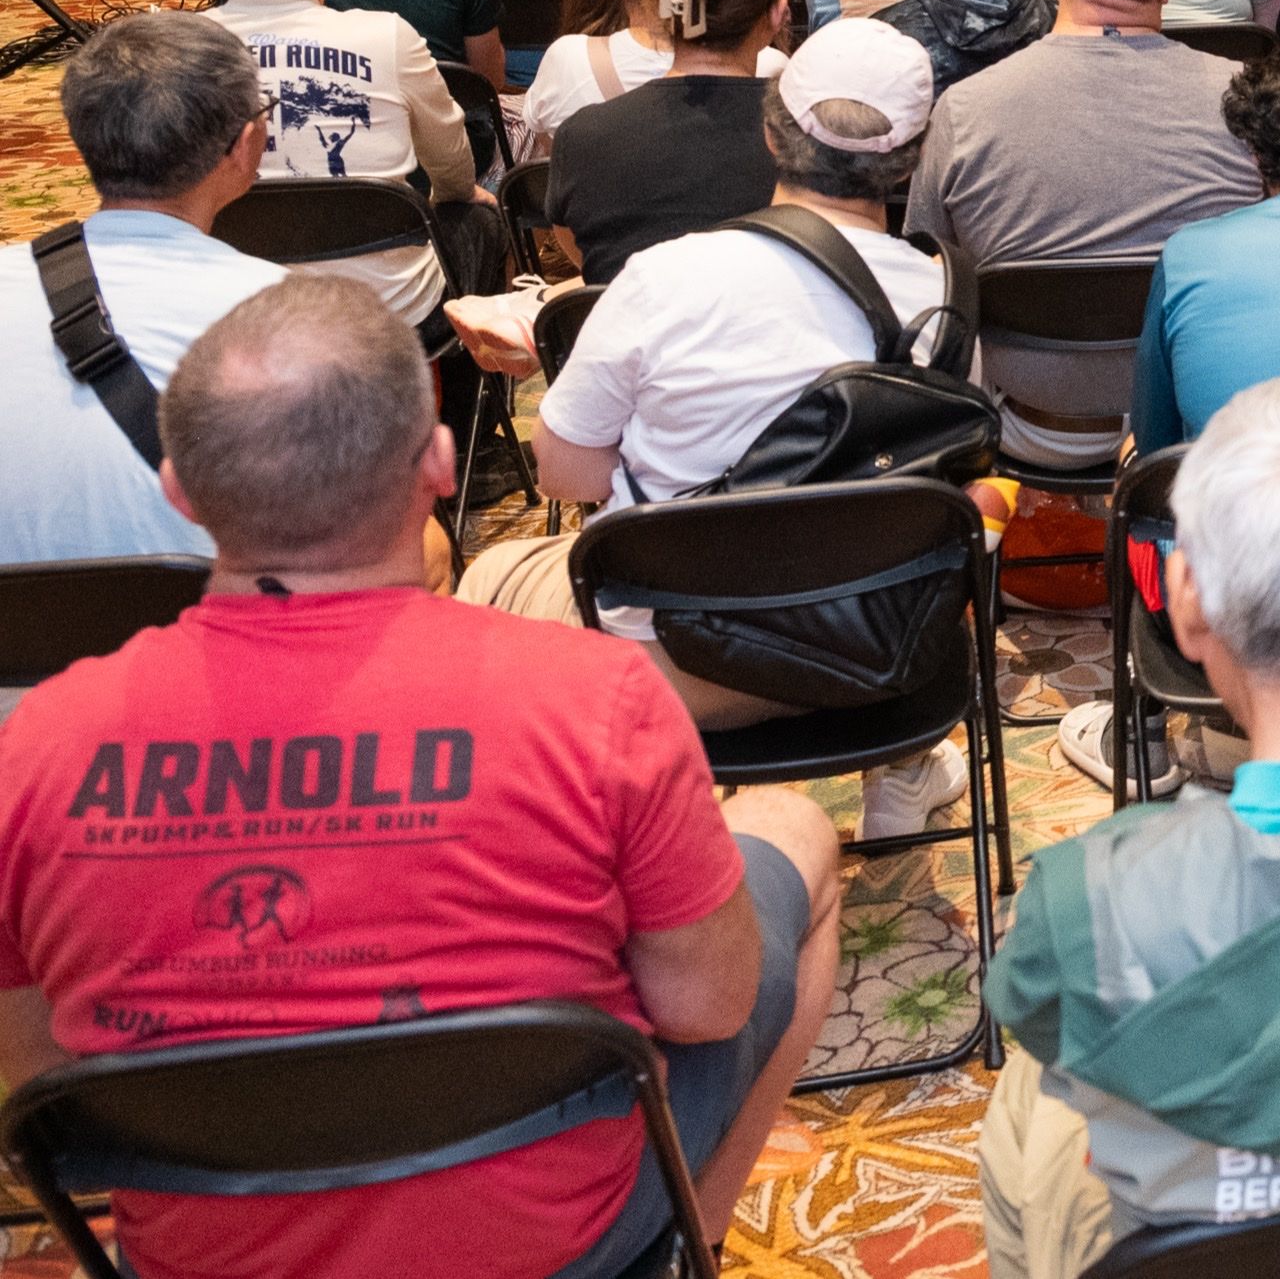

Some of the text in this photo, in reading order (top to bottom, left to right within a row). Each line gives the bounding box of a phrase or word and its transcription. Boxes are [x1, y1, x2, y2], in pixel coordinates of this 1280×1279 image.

[287, 44, 373, 83] ROADS
[67, 727, 474, 818] ARNOLD
[84, 825, 114, 844] 5K
[376, 811, 439, 831] RUN
[266, 943, 390, 970] RUNNING
